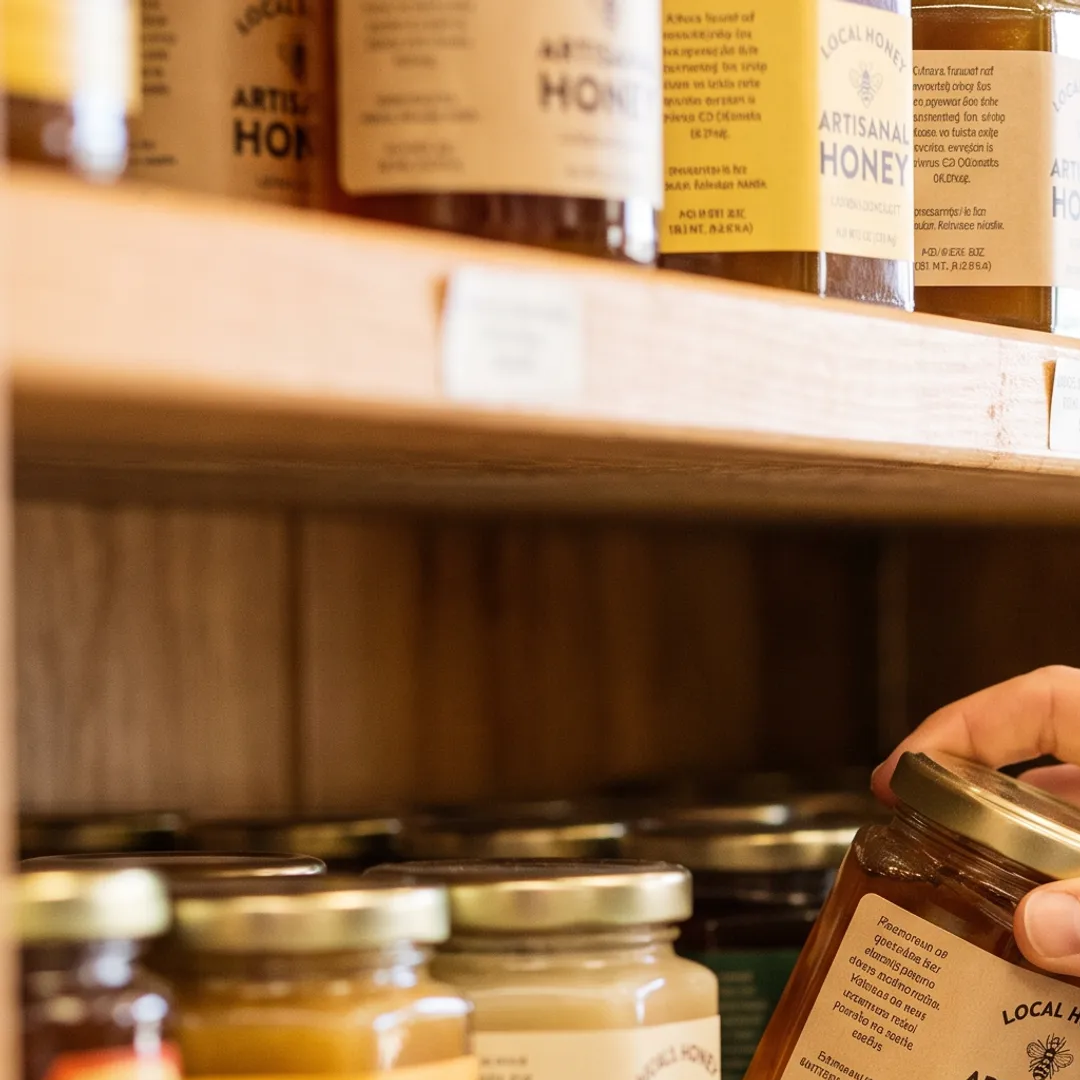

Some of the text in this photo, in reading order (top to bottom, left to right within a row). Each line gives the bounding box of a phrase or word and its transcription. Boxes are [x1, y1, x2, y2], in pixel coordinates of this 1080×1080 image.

[820, 24, 907, 73] LOCAL HONEY
[818, 110, 910, 145] ARTISANAL
[819, 140, 908, 187] HONEY
[1002, 1001, 1064, 1025] LOCAL
